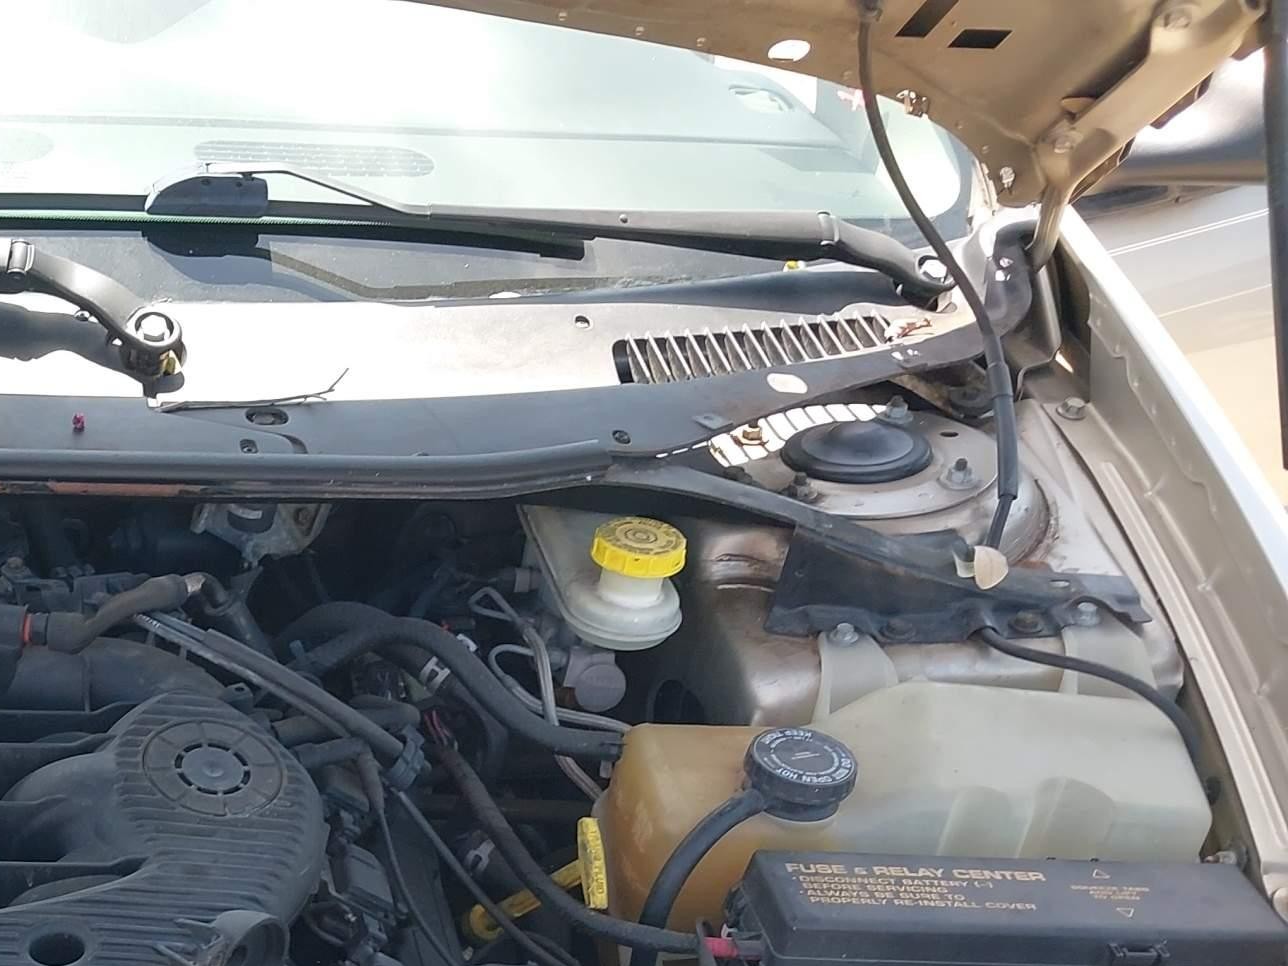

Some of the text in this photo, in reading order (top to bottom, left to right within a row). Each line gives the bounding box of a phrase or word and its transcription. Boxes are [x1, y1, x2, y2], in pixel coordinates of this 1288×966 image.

[776, 768, 798, 780] HOT
[784, 863, 1046, 882] FUSE & RELAY CENTER
[799, 875, 895, 886] DISCONNECT
[903, 878, 969, 888] BATTERY
[802, 882, 949, 894] BEFORE SERVICING
[807, 890, 966, 901] ALWAYS BE SURE TO
[810, 896, 887, 905] PROPERLY
[984, 901, 1038, 911] COVER
